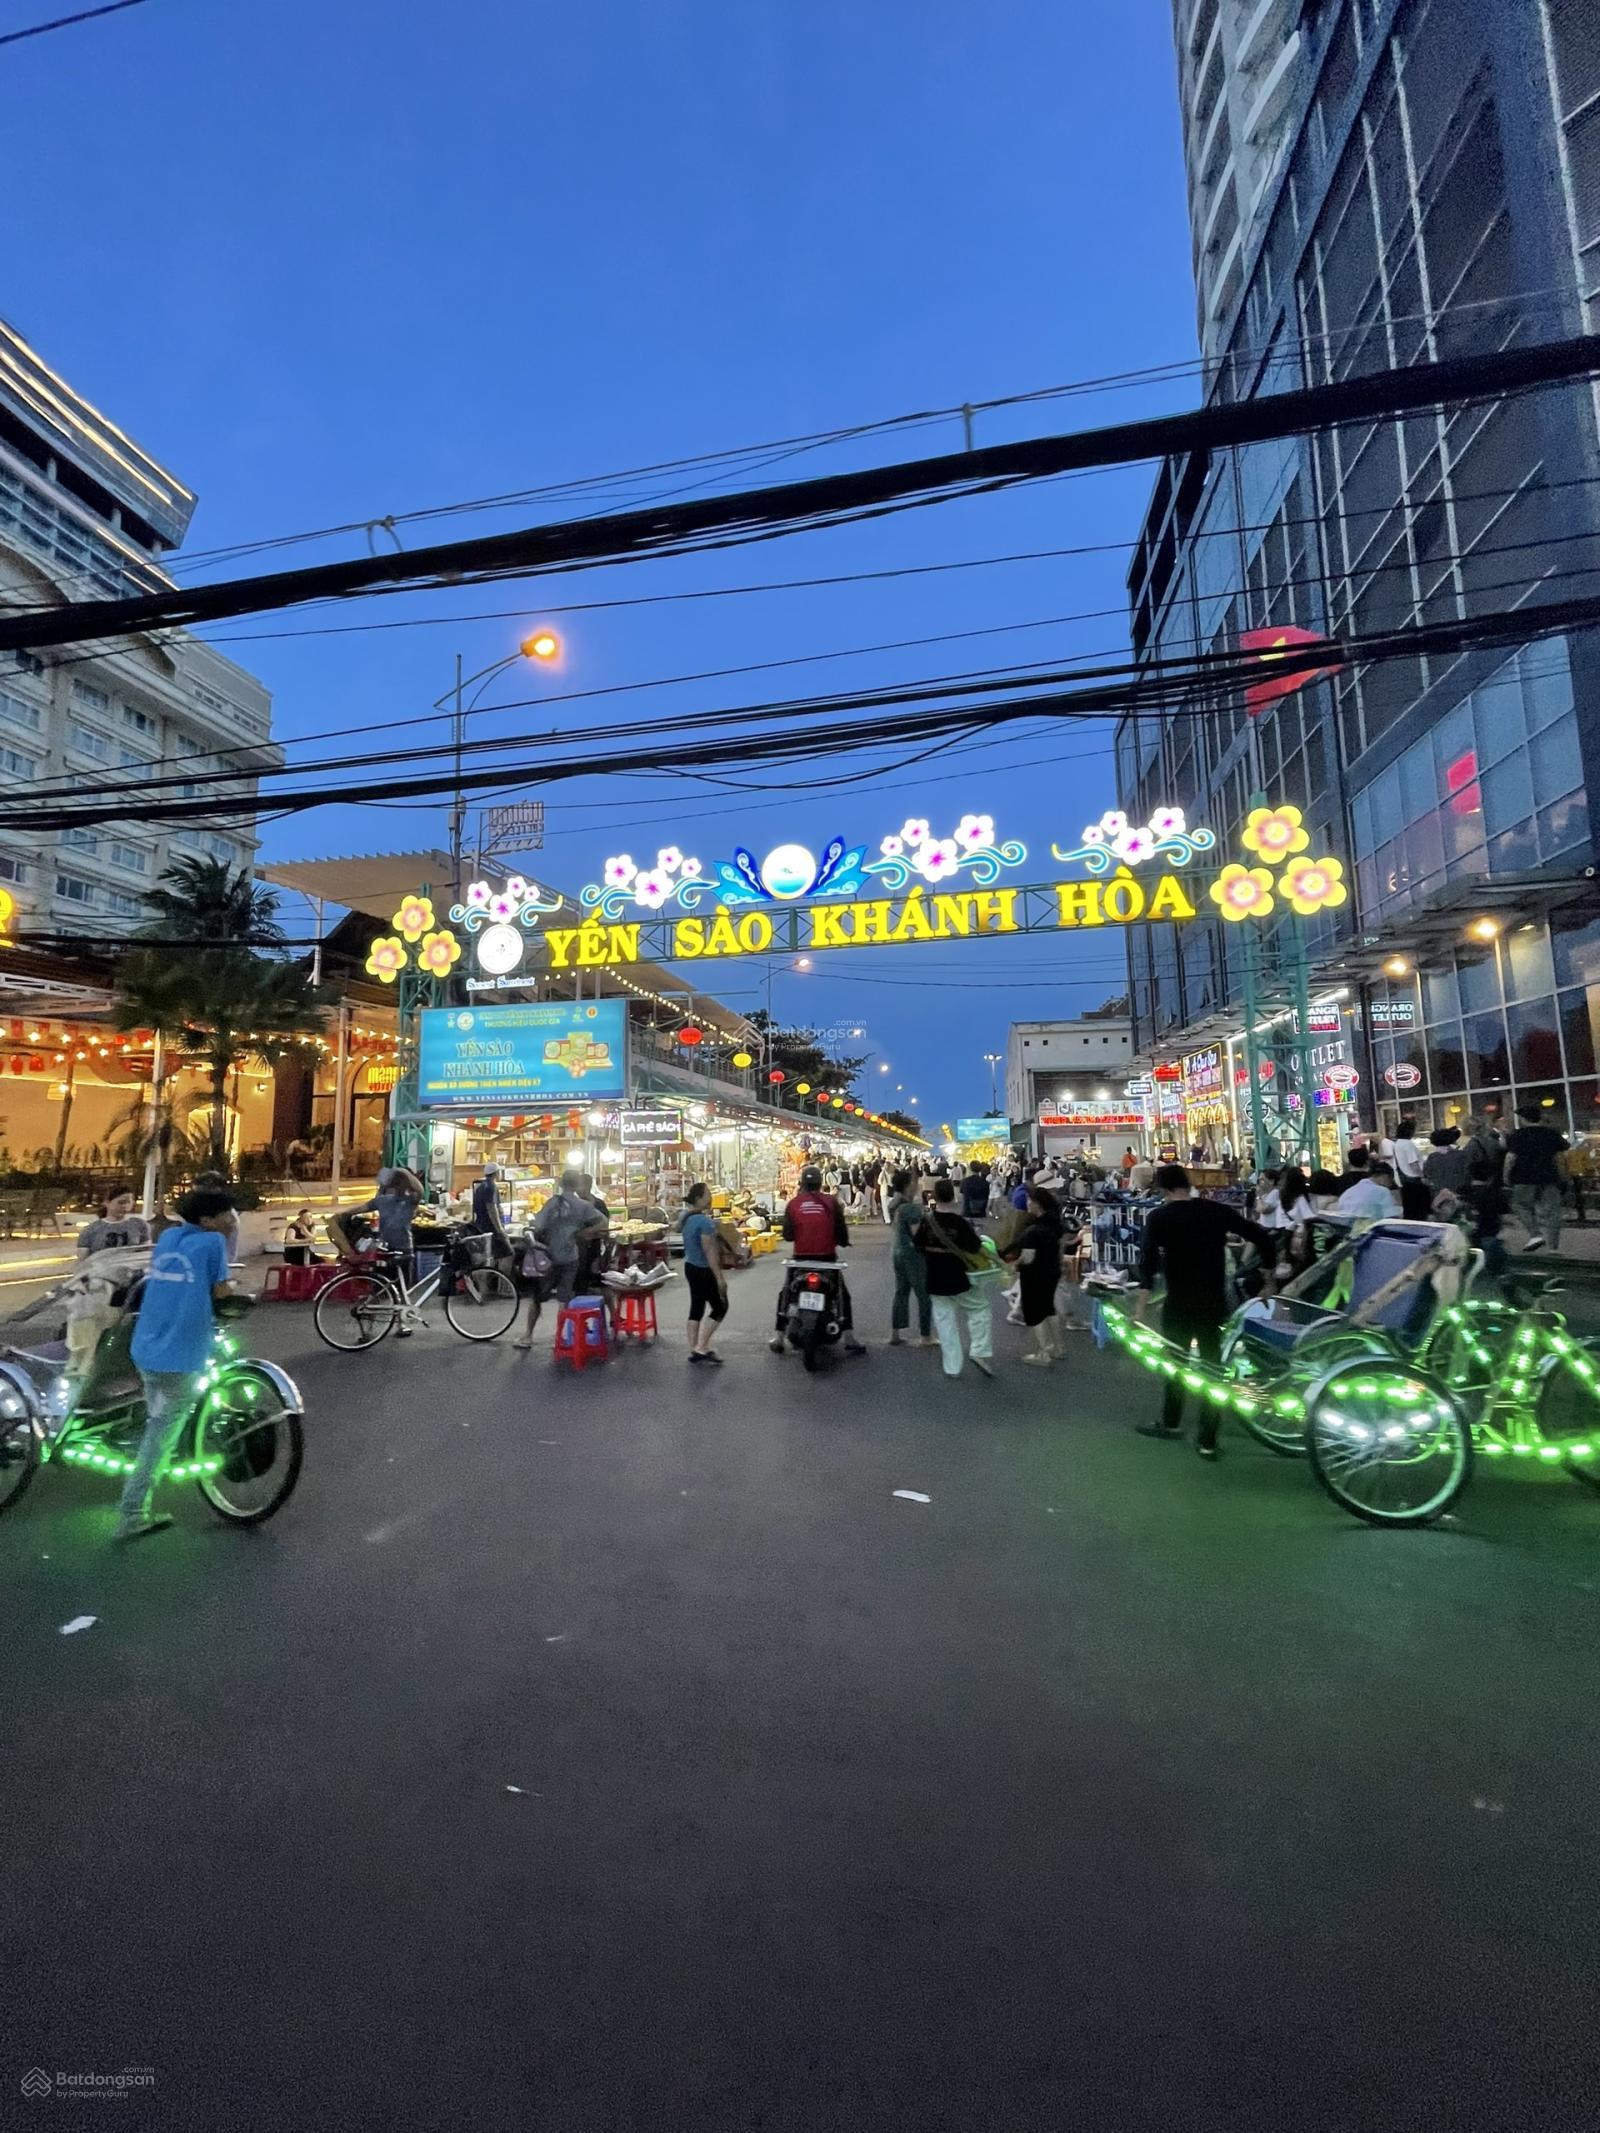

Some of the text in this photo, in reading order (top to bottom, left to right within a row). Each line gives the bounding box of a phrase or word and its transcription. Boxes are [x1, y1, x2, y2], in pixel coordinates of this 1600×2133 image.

[545, 867, 1196, 967] YẾN SÀO KHÁNH HÒA
[456, 1037, 514, 1059] YẾN SÀO
[443, 1056, 526, 1079] KHÁNH HÒA
[637, 1120, 654, 1133] PHÊ
